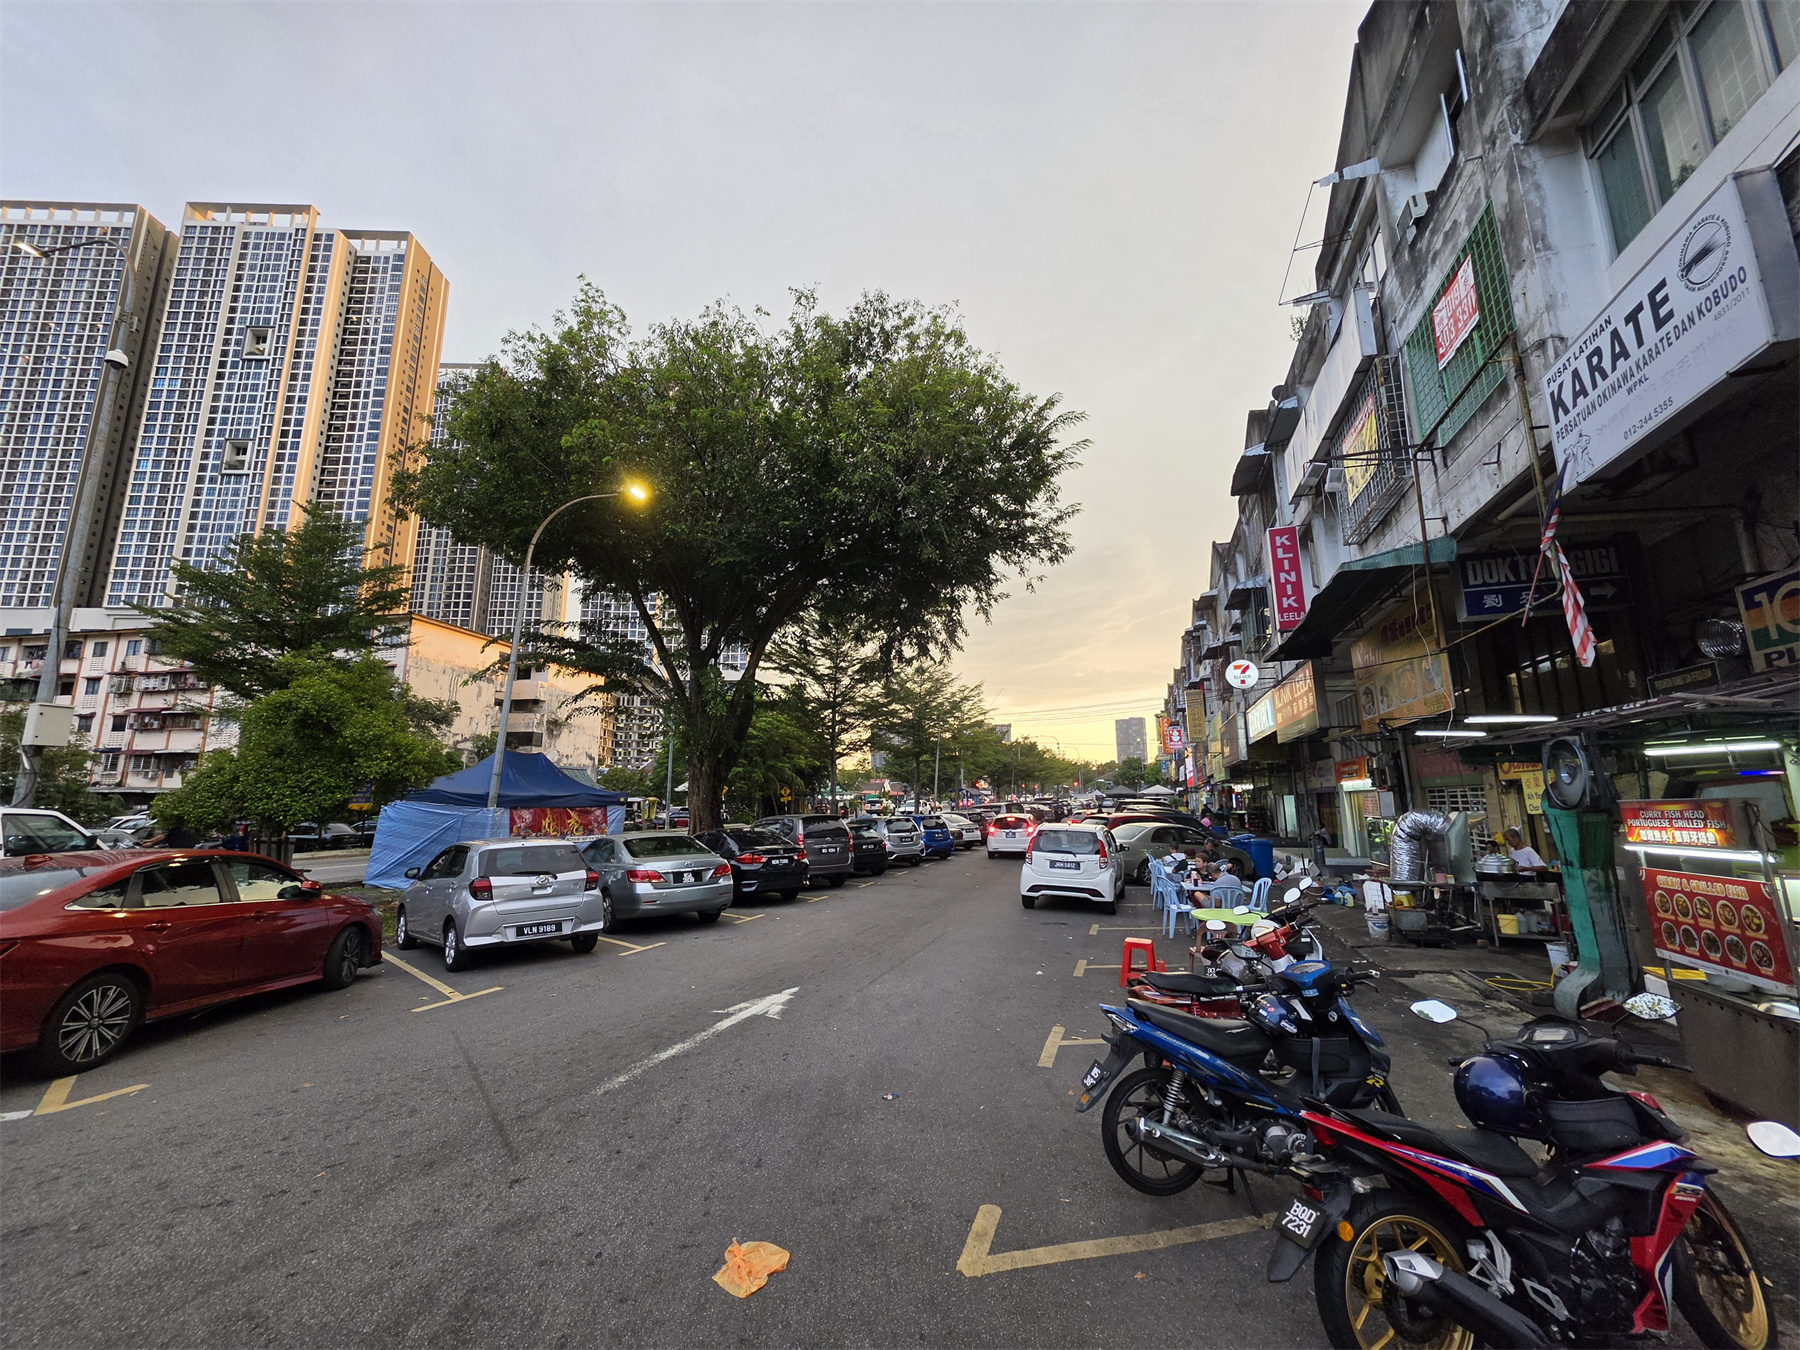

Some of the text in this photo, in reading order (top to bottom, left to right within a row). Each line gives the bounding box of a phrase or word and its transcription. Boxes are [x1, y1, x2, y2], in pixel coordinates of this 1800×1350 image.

[1546, 315, 1612, 388] PUSAT LATIHAN
[1549, 277, 1675, 425] KARATE
[1555, 398, 1597, 443] PERSATUAN
[1596, 365, 1636, 408] OKINAWA
[1635, 332, 1673, 375] KARATE
[1673, 310, 1696, 342] DAN
[1696, 266, 1747, 321] KOBUDO
[1625, 373, 1650, 396] WPKL
[1623, 412, 1653, 440] 012-244
[1654, 396, 1674, 418] 5355
[1275, 534, 1299, 608] KLINIK
[1571, 546, 1619, 576] GIGI
[1278, 611, 1306, 622] LEELA
[1627, 819, 1726, 829] PORTUGUESE GRILLED FISH
[1640, 810, 1705, 819] CURRY FISH HEAD
[1656, 875, 1749, 901] CURRY & GRILLED FISH
[523, 924, 556, 935] VLN 9189
[1281, 1211, 1312, 1238] 7231
[1290, 1201, 1317, 1224] BQD
